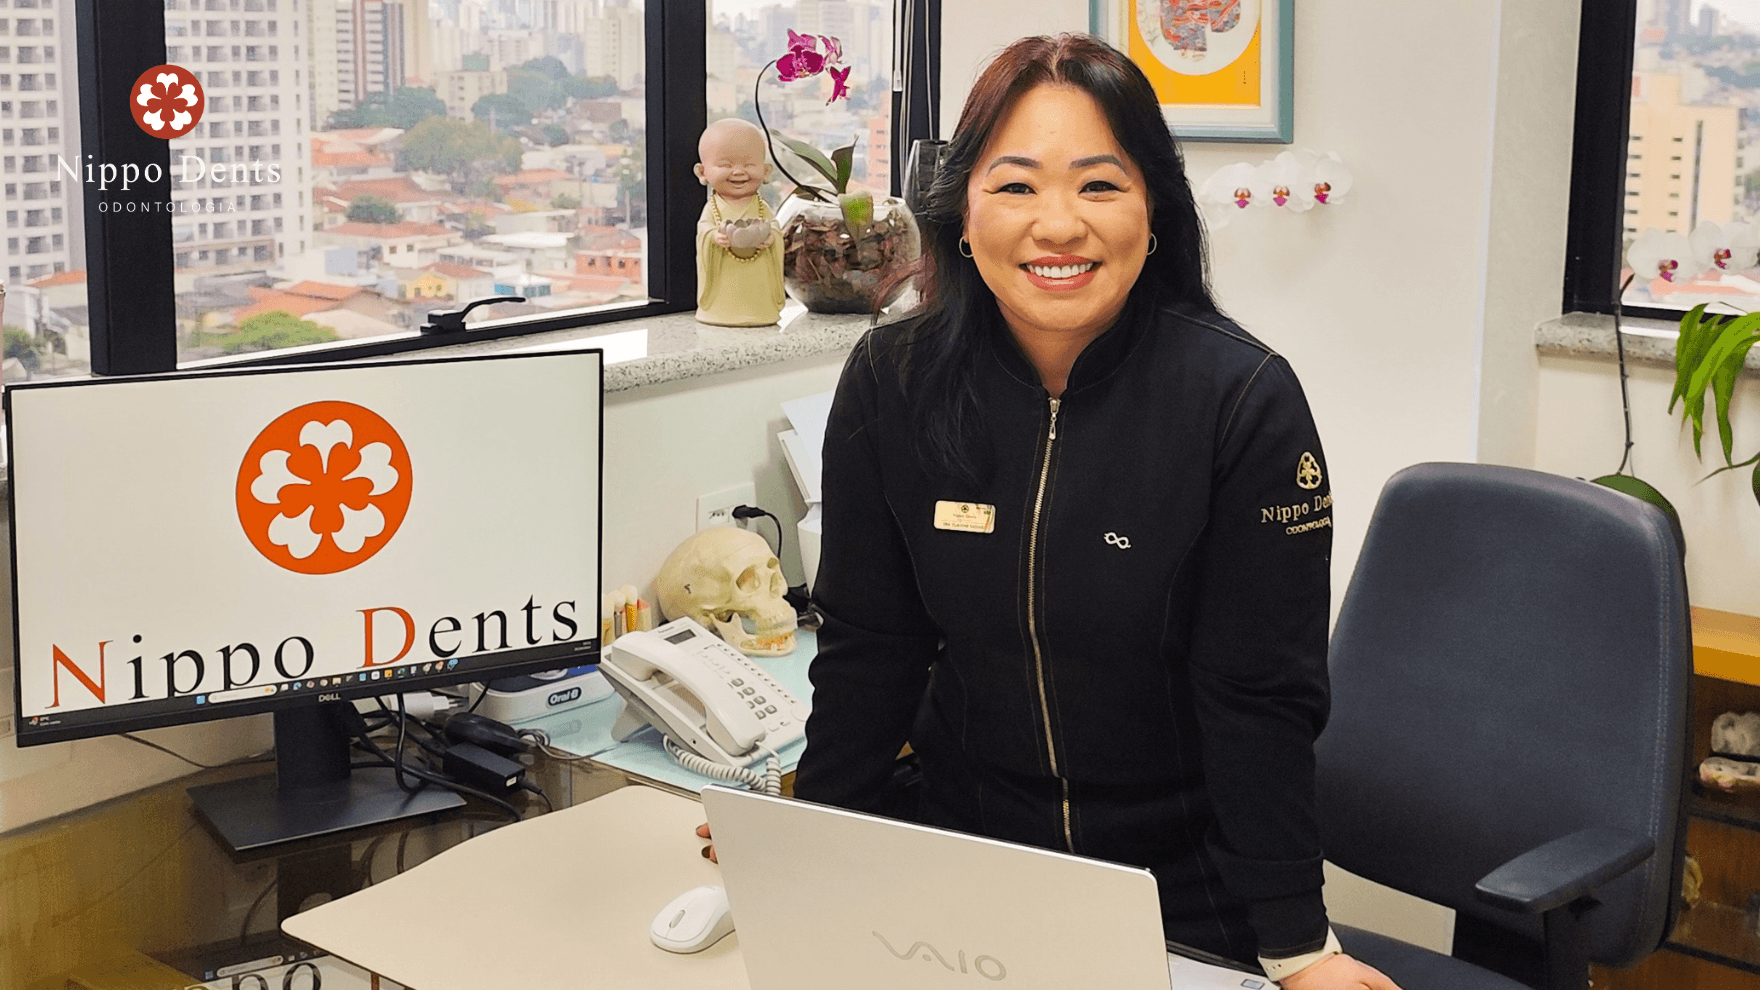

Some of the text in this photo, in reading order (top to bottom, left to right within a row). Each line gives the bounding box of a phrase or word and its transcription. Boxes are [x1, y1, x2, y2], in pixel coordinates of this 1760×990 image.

[1260, 502, 1310, 524] Nippo
[44, 593, 579, 709] Nippo Dents
[317, 692, 342, 703] DELL
[871, 930, 1007, 982] VAIO
